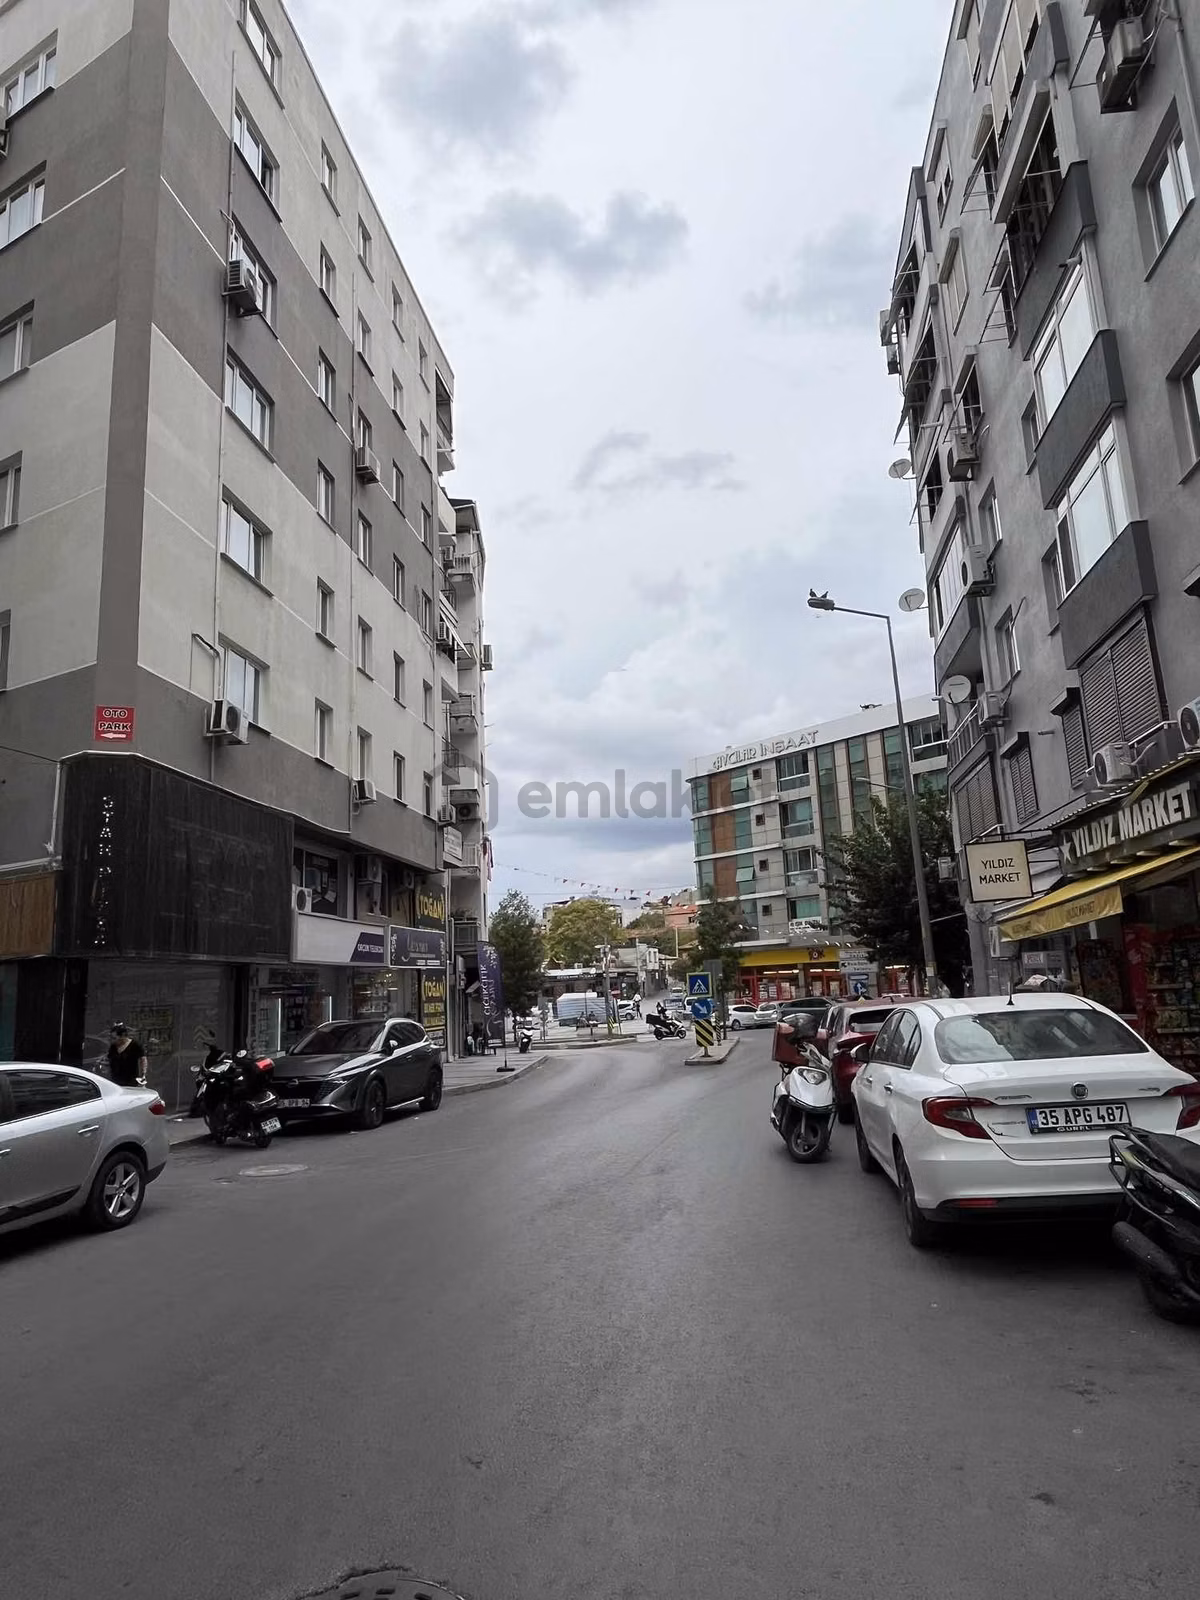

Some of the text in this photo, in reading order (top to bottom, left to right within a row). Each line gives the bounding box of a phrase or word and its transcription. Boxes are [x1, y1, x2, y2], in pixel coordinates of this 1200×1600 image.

[102, 708, 128, 719] OTO
[98, 721, 132, 732] PARK
[1071, 781, 1192, 858] YILDIZ MARKET
[981, 858, 1015, 869] YILDIZ
[979, 872, 1021, 884] MARKET
[1039, 1110, 1060, 1126] 35
[1064, 1107, 1093, 1124] APG
[1096, 1105, 1124, 1123] 487
